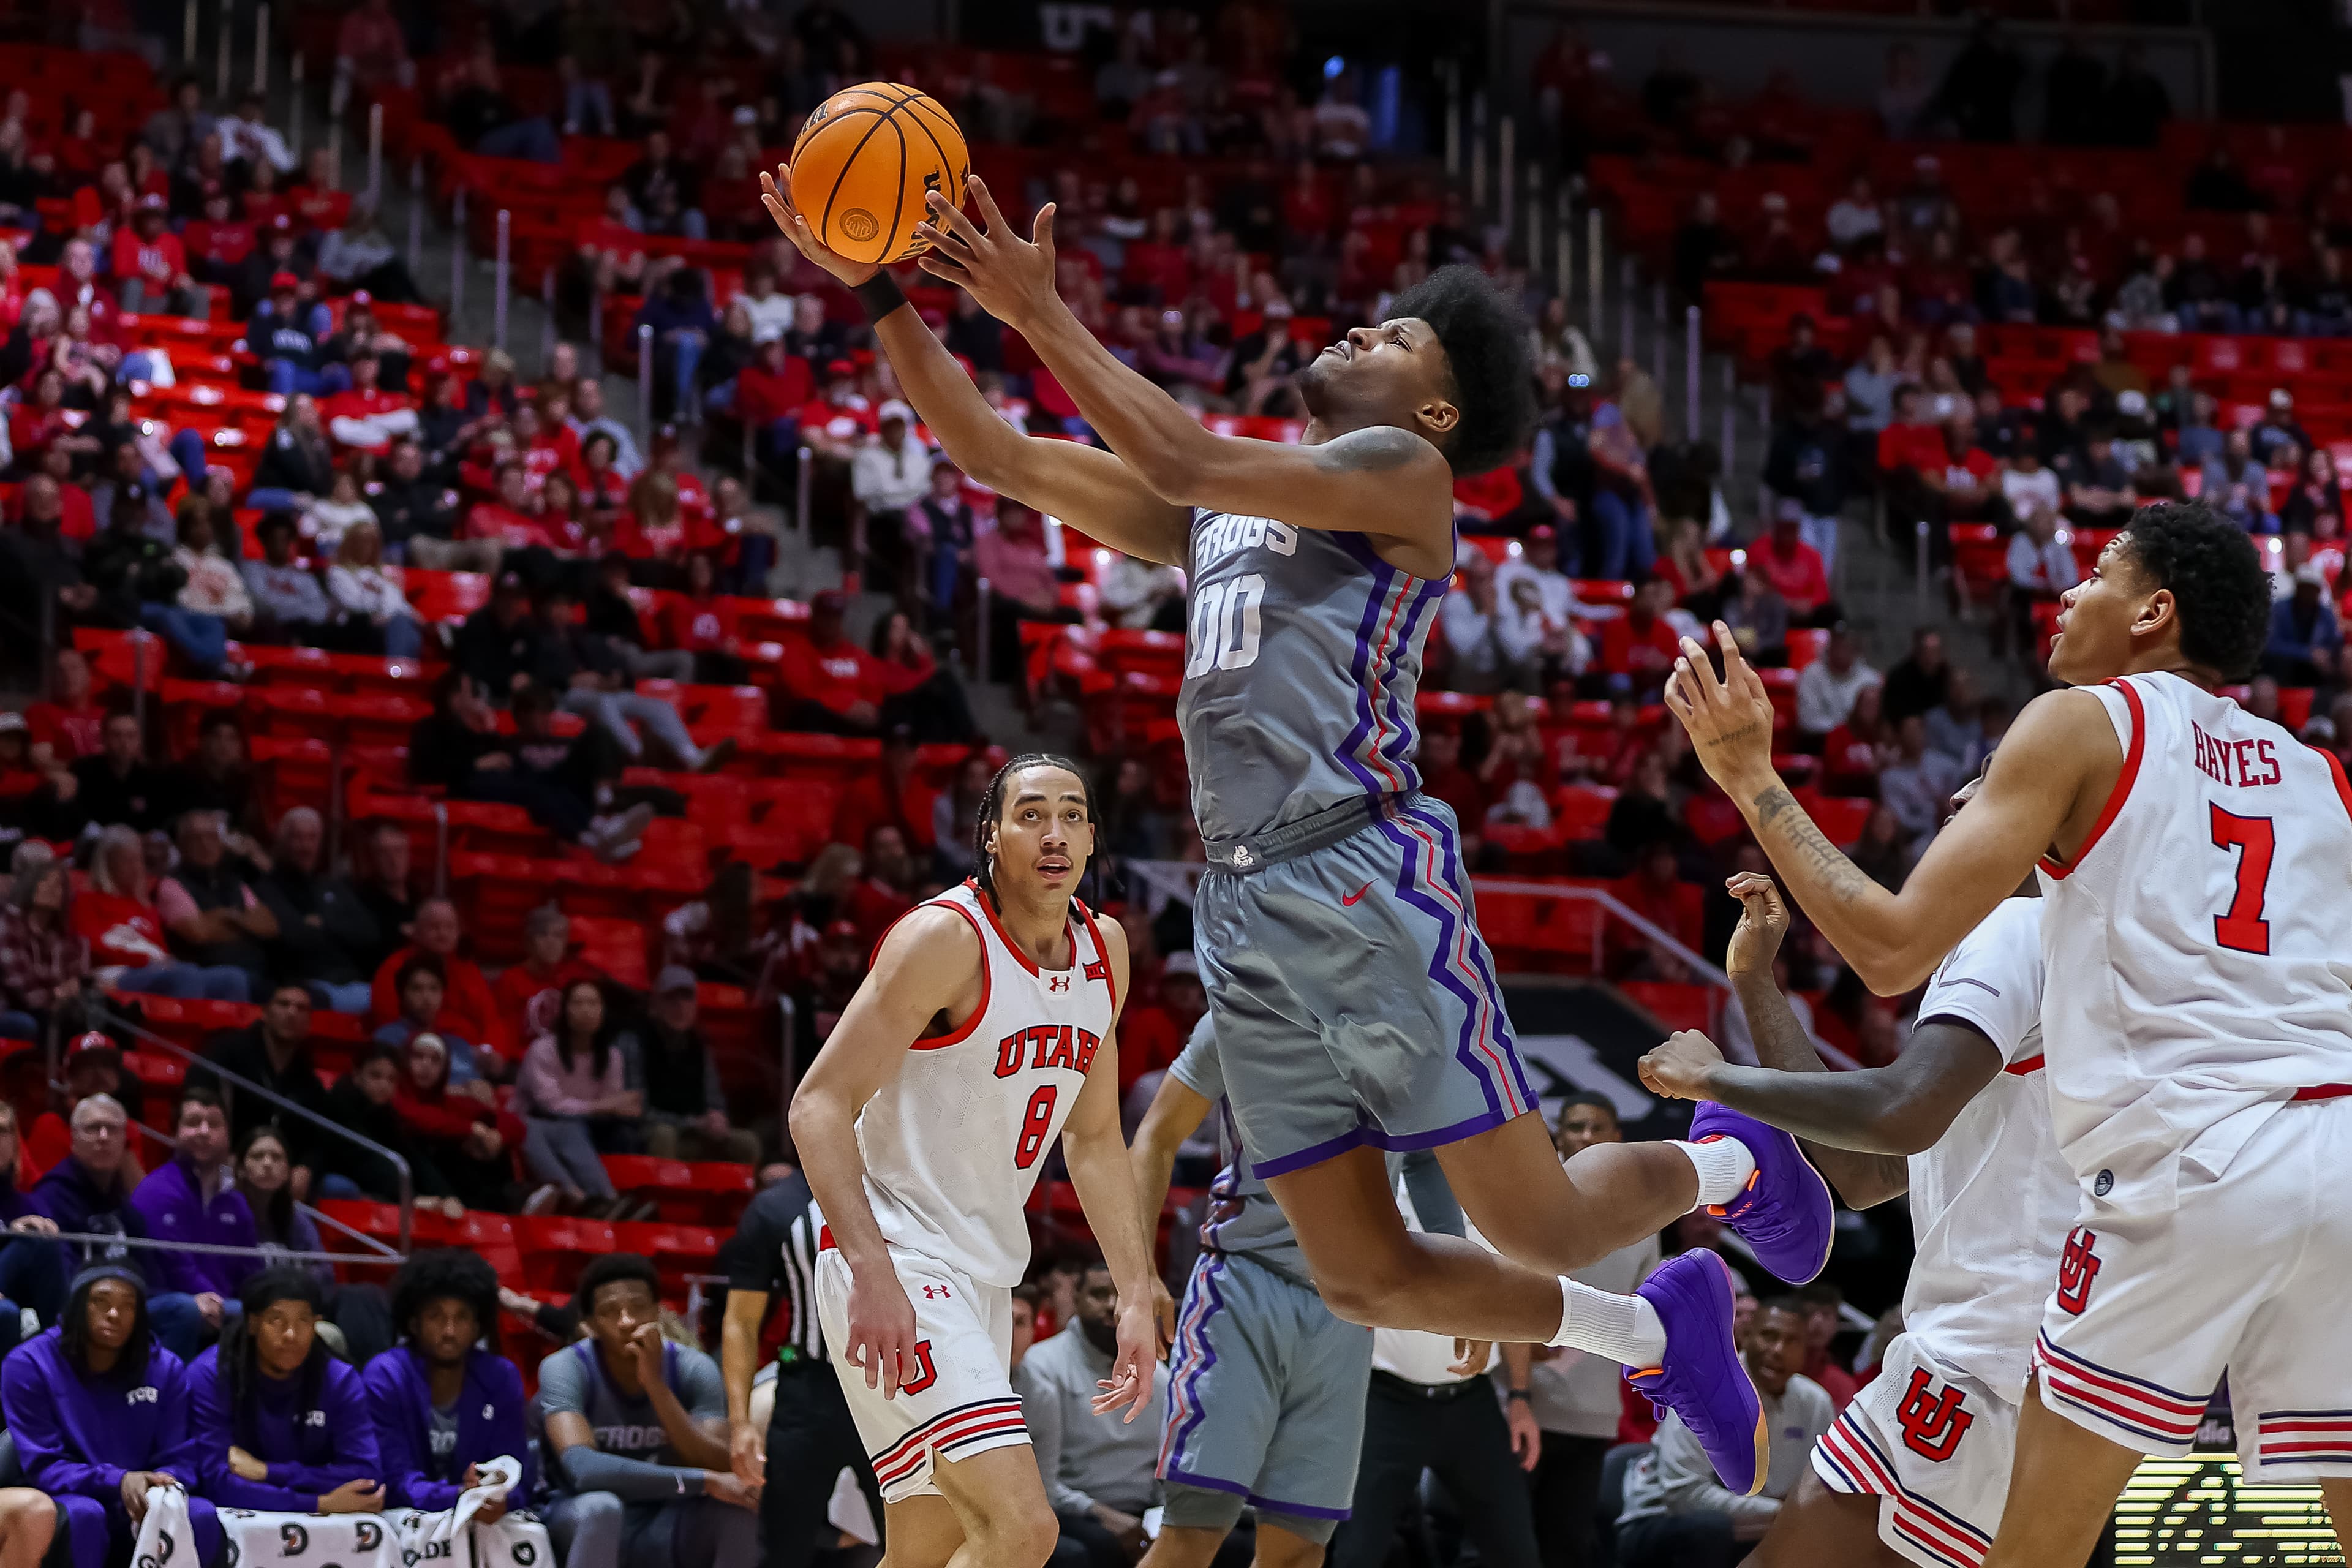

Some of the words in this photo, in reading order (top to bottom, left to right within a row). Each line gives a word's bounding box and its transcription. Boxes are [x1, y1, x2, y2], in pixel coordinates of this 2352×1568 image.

[1186, 573, 1266, 679] 00
[2191, 719, 2282, 787] HAYES
[2209, 799, 2276, 956] 7
[993, 1024, 1101, 1079] UTAH
[1014, 1084, 1057, 1169] 8
[594, 1425, 665, 1450] FROG
